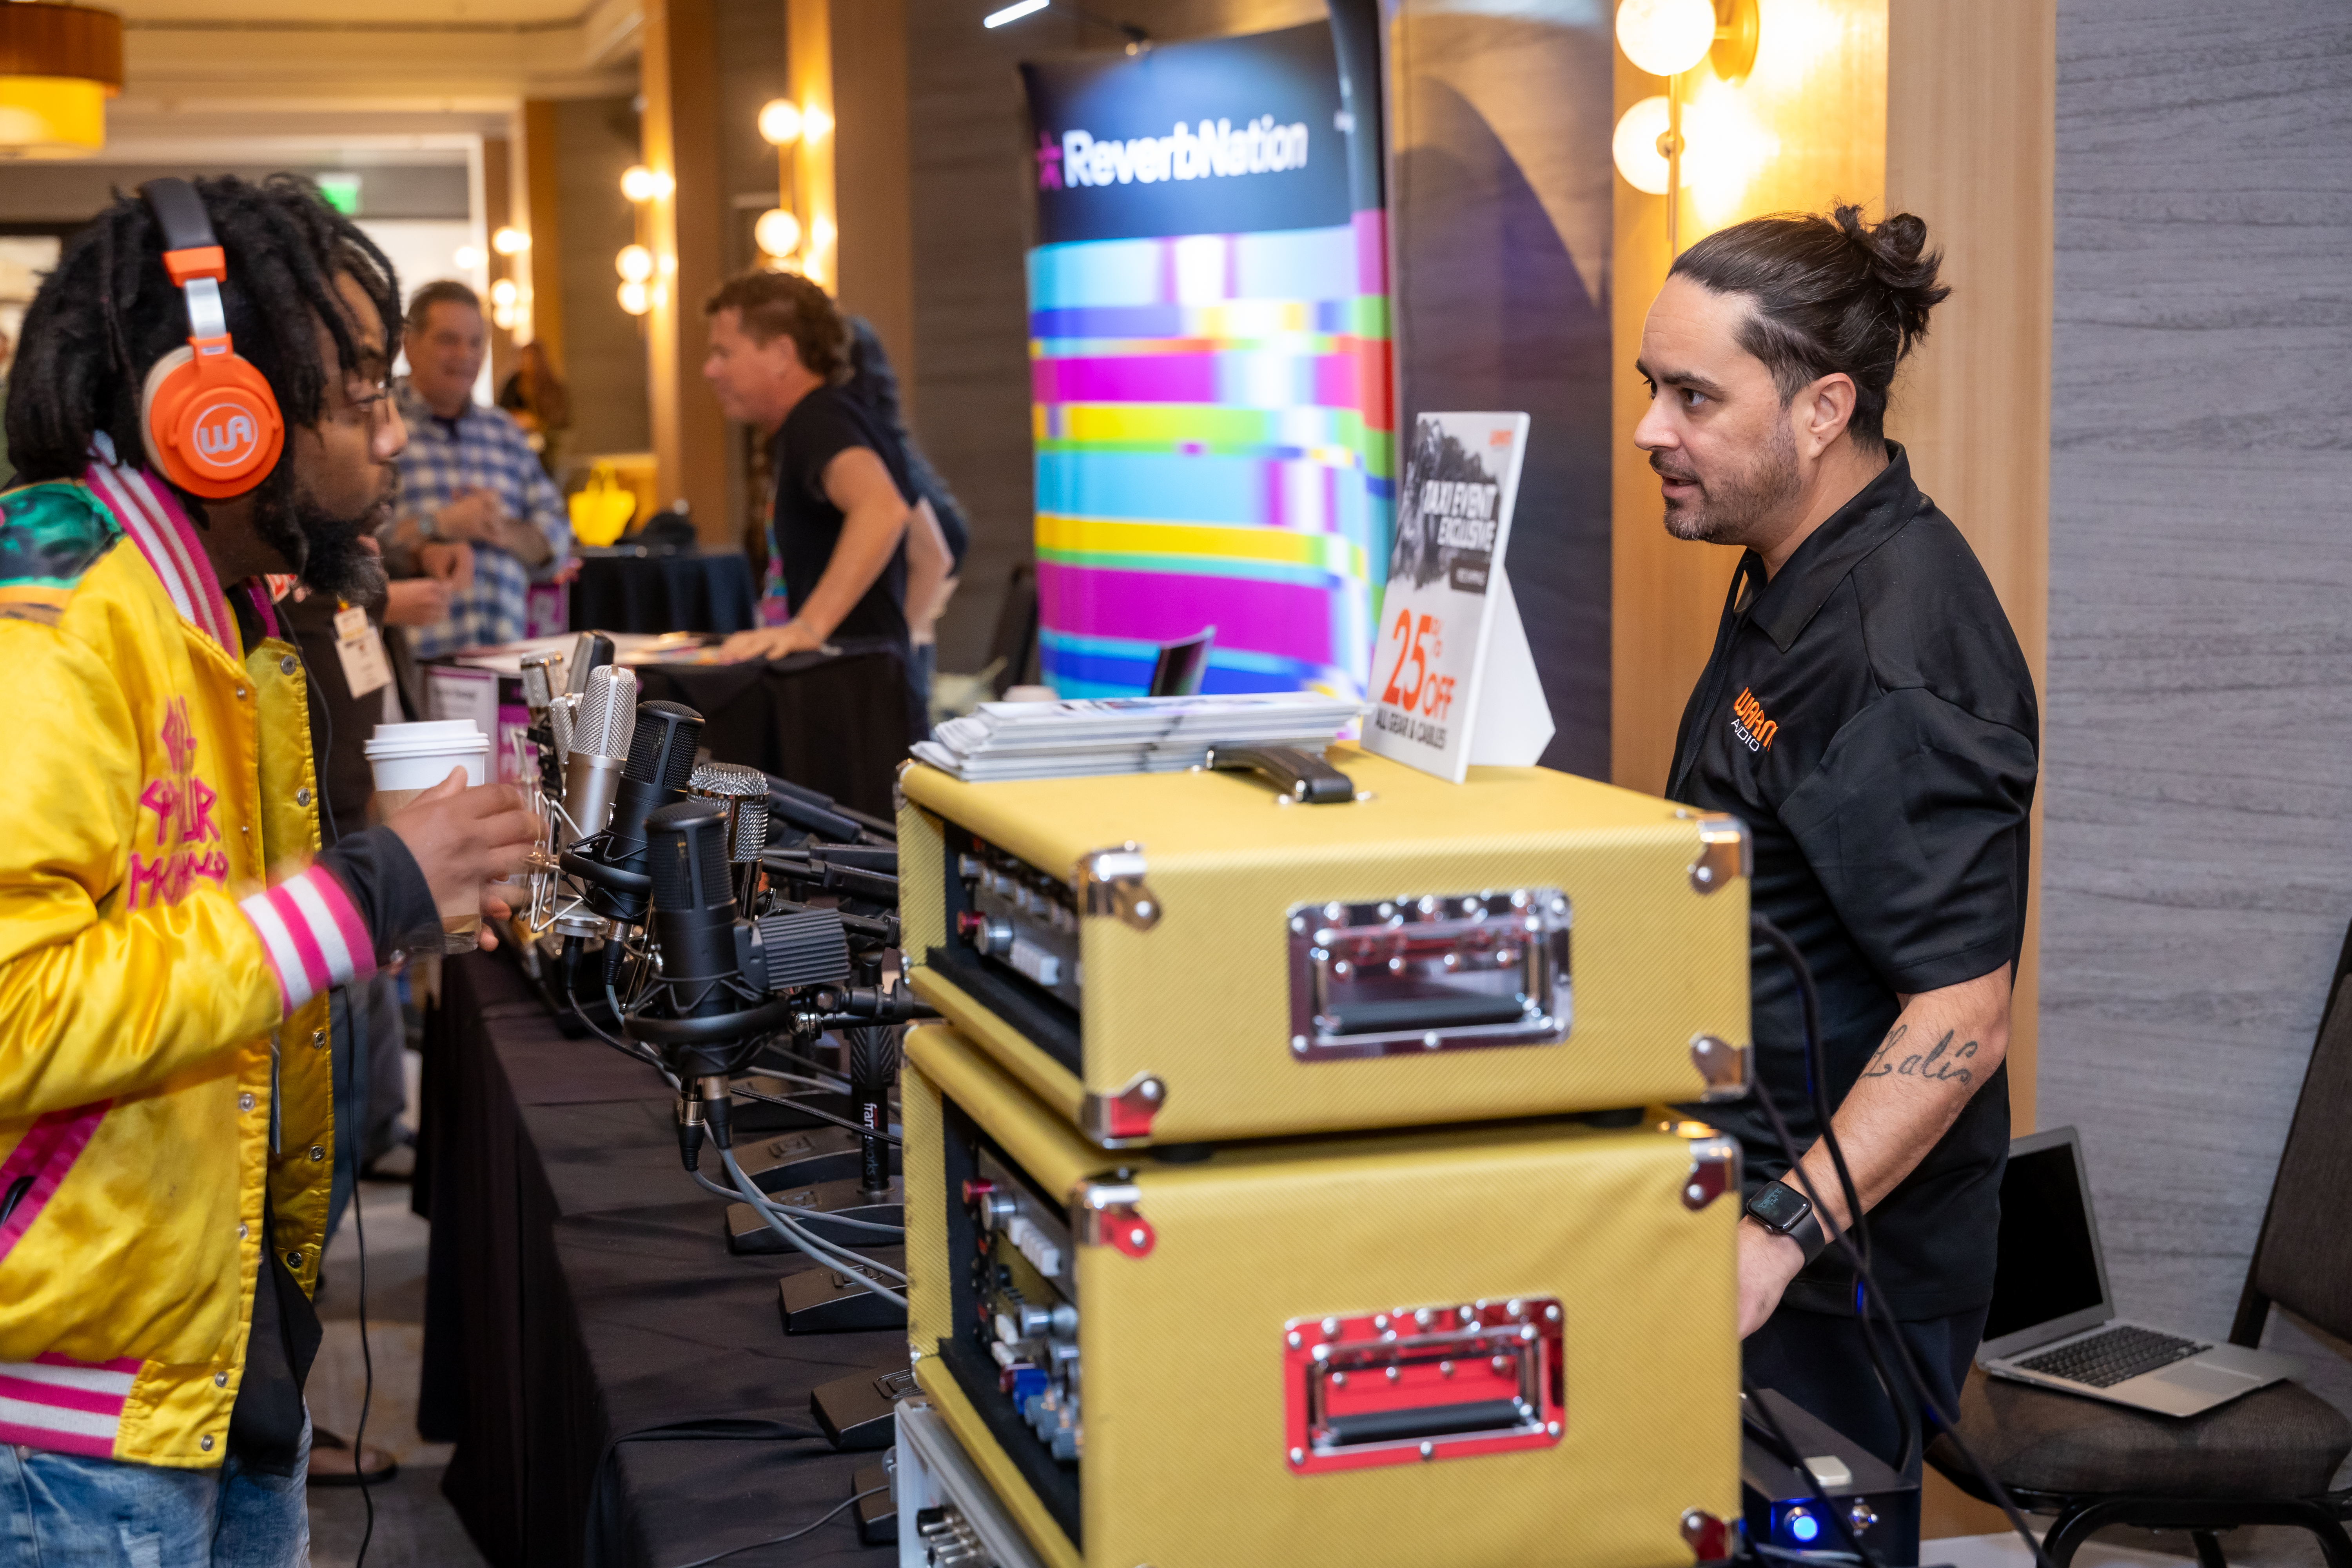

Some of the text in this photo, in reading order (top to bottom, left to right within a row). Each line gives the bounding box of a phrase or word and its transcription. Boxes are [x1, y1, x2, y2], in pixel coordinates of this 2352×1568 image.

[1062, 113, 1308, 188] ReverbNation
[200, 415, 252, 455] WA
[1423, 672, 1457, 722] OFF
